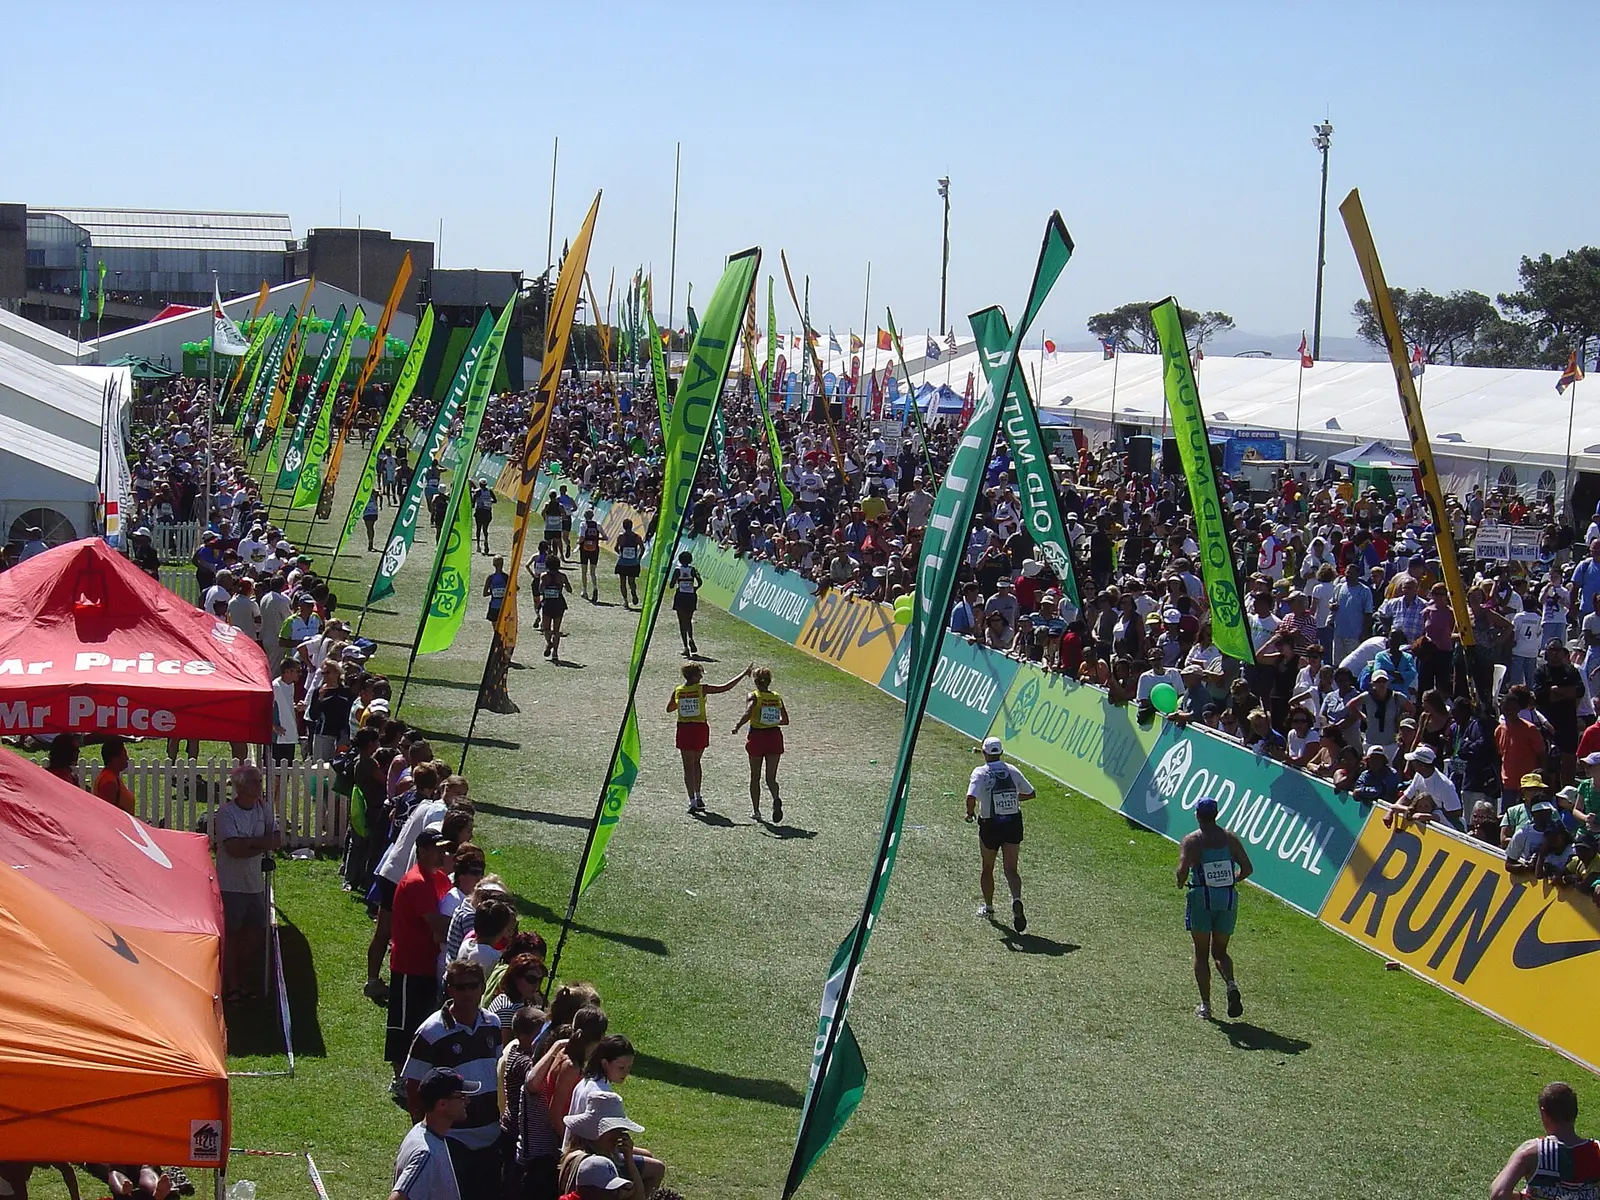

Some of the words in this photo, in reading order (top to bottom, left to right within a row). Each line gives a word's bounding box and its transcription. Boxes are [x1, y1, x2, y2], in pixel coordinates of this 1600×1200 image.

[294, 403, 311, 441] OLD
[308, 328, 339, 400] MUTUAL
[311, 416, 328, 457] OLD
[1238, 430, 1250, 438] Ice
[753, 580, 777, 609] OLD
[768, 587, 809, 625] MUTUAL
[802, 592, 860, 661] RUN
[1525, 626, 1532, 639] 4
[75, 651, 217, 676] Price
[938, 660, 998, 715] MUTUAL
[0, 700, 51, 730] Mr
[69, 695, 177, 731] Price
[1031, 700, 1070, 745] OLD
[1061, 714, 1137, 778] MUTUAL
[1181, 768, 1236, 822] OLD
[1226, 789, 1335, 876] MUTUAL
[1340, 828, 1528, 986] RUN
